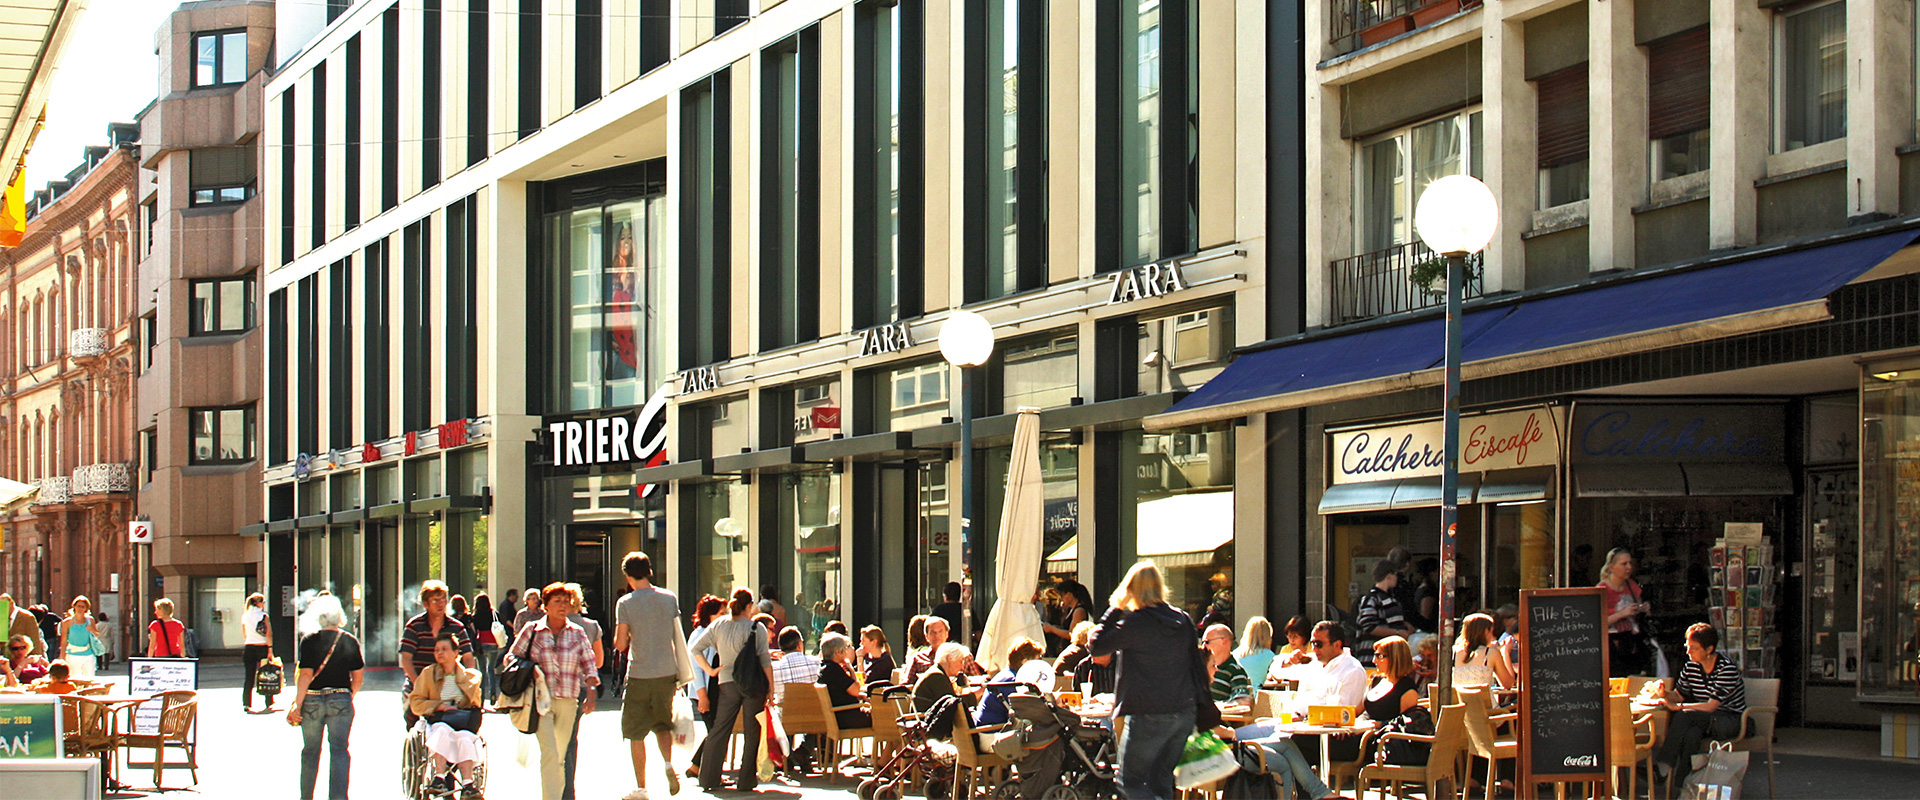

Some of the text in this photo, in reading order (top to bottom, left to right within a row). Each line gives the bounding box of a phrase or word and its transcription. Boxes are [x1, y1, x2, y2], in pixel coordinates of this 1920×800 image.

[1107, 260, 1184, 306] ZARA
[858, 322, 911, 358] ZARA
[679, 366, 719, 396] ZARA
[549, 416, 631, 467] TRIER
[1463, 412, 1544, 465] Eiscafé
[1580, 409, 1769, 457] Calchera
[1532, 605, 1560, 622] Alle
